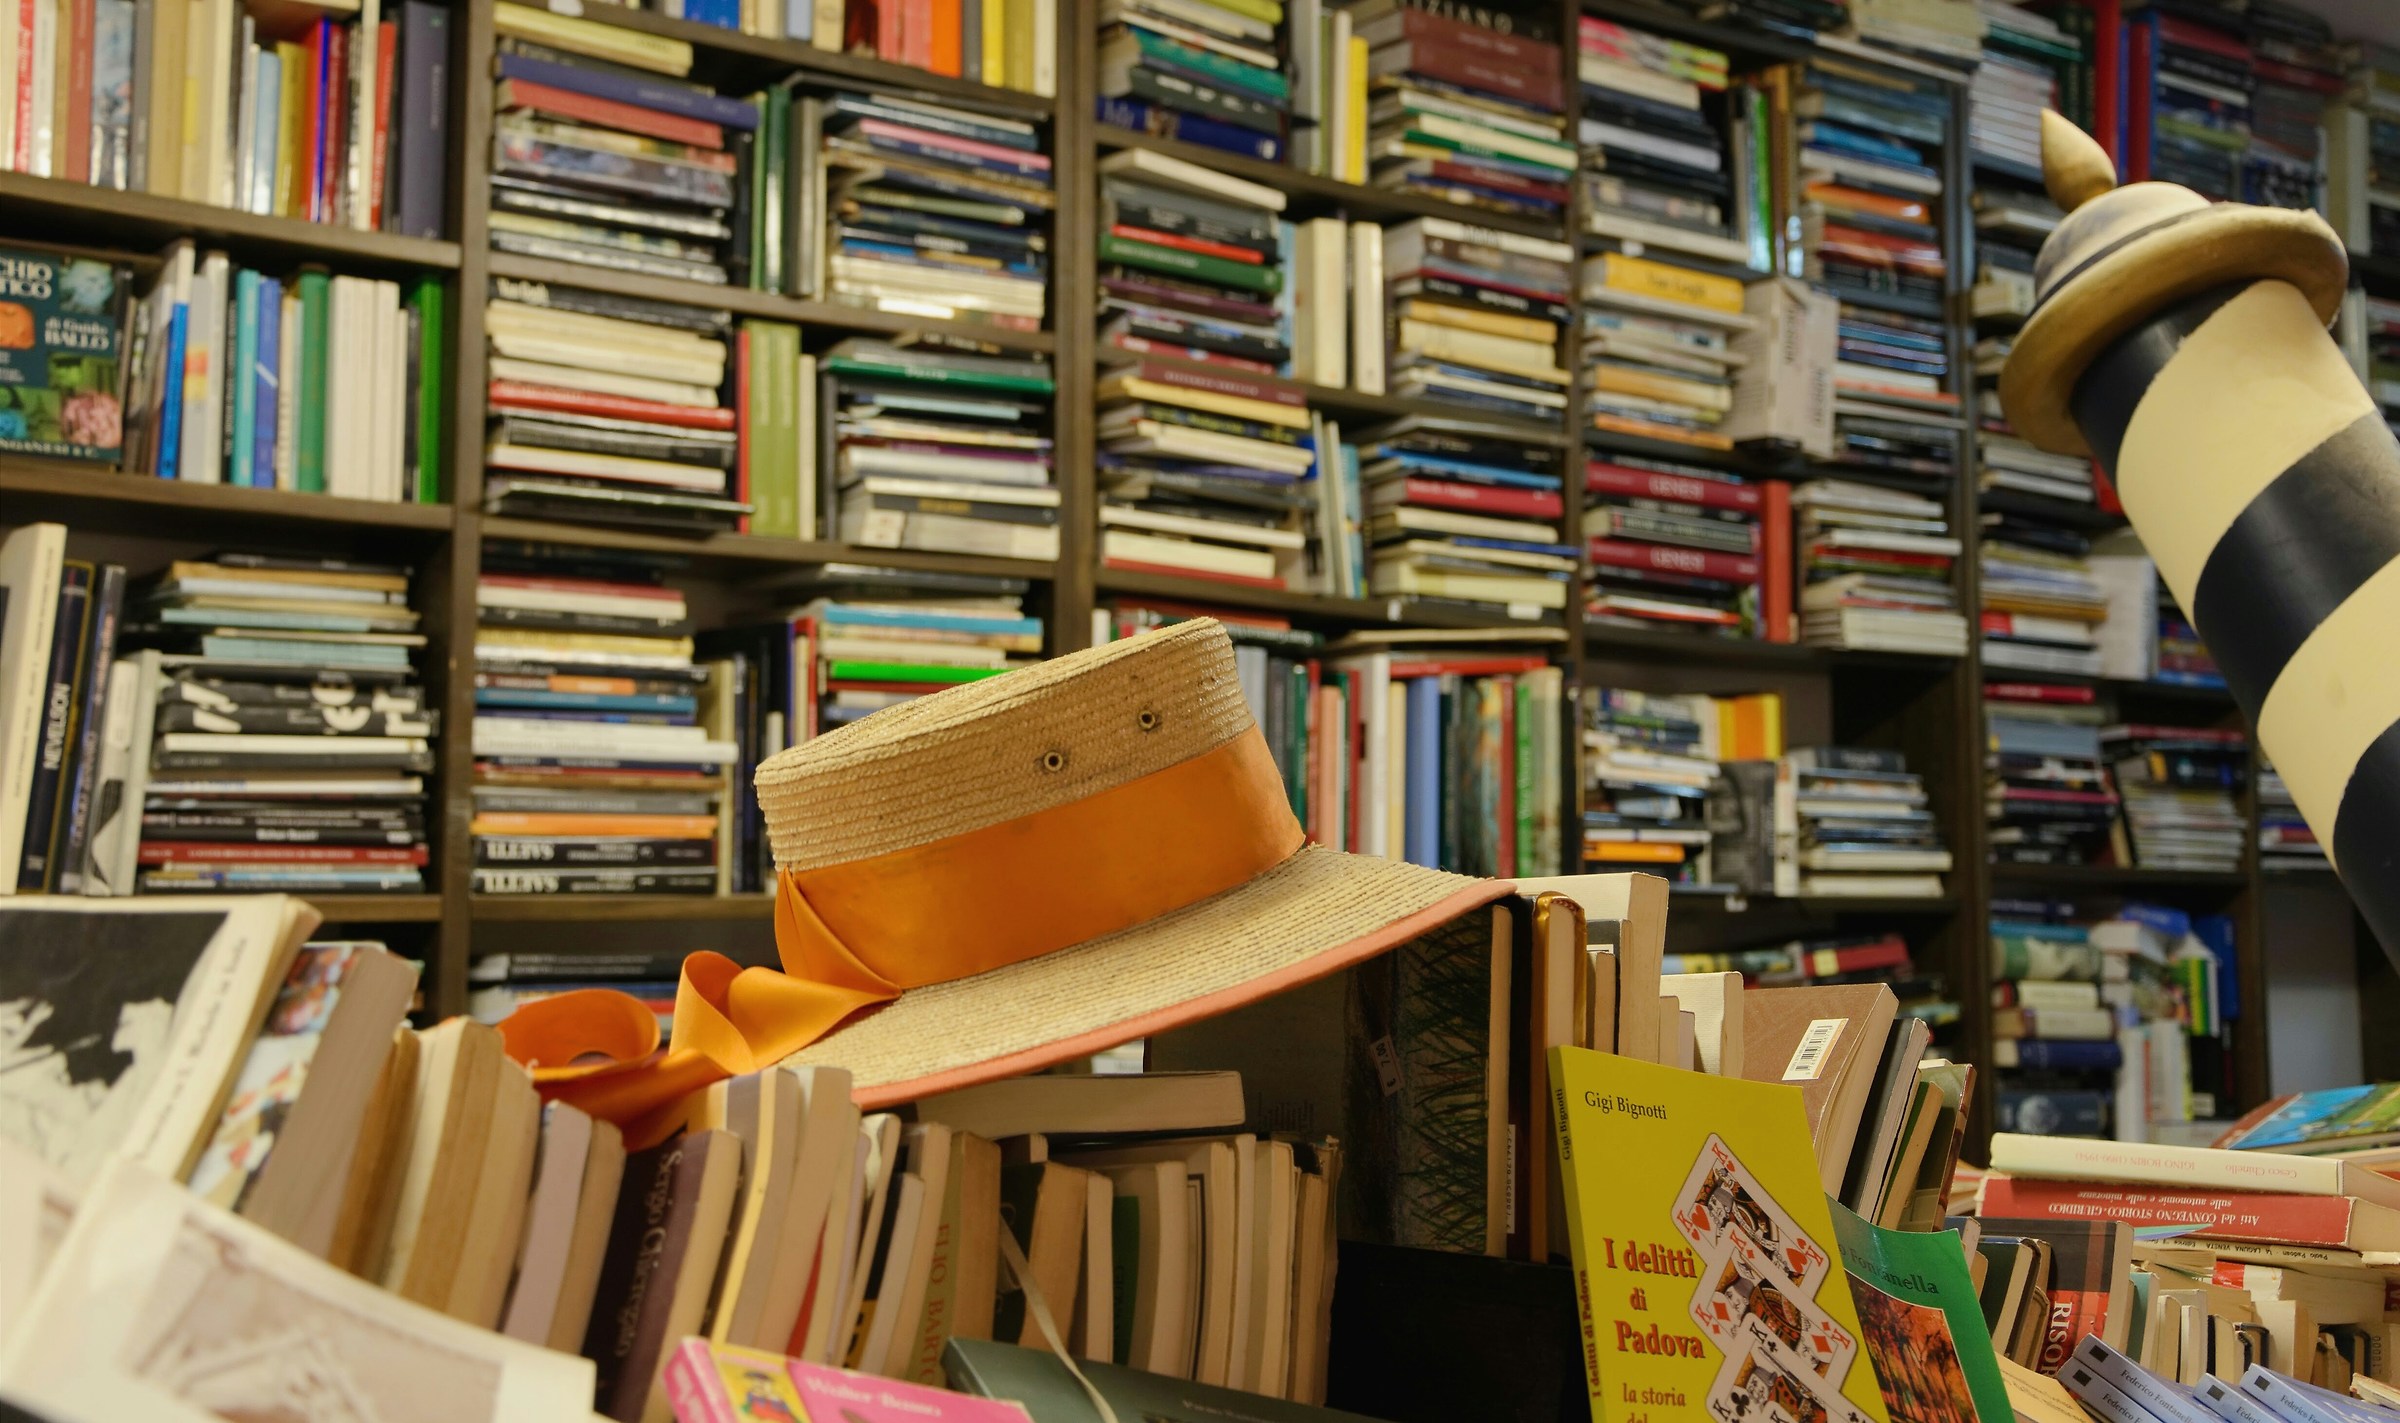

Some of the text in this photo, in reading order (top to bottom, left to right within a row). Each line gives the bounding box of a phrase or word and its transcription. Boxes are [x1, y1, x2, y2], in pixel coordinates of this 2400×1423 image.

[43, 682, 71, 770] NEVELSON
[1585, 1090, 1668, 1120] Gigi Bignotti
[1554, 1088, 1571, 1161] Gigi Bignotti
[1711, 1142, 1729, 1166] K
[2164, 1159, 2195, 1171] IGINO
[2267, 1167, 2298, 1180] Cesco
[2077, 1190, 2123, 1204] minoranze
[2125, 1193, 2151, 1205] sulle
[2158, 1195, 2207, 1207] autonomie
[2209, 1199, 2233, 1210] sulle
[1676, 1209, 1694, 1233] K
[2156, 1207, 2217, 1225] CONVEGNO
[2220, 1212, 2236, 1225] del
[2241, 1214, 2260, 1227] Atti
[1729, 1228, 1747, 1251] K
[1602, 1237, 1698, 1279] I delitti
[1805, 1245, 1824, 1267] K
[1578, 1269, 1592, 1322] Padova
[1629, 1287, 1648, 1312] di
[1694, 1303, 1713, 1327] K
[1583, 1324, 1594, 1340] di
[1614, 1319, 1706, 1359] Padova
[1749, 1321, 1768, 1345] K
[1830, 1328, 1851, 1350] K
[1585, 1342, 1600, 1387] delitti
[1622, 1382, 1686, 1407] la storia
[2120, 1369, 2154, 1397] Federico
[1712, 1398, 1731, 1422] K
[2102, 1393, 2134, 1421] Federico
[2280, 1394, 2308, 1419] Federico
